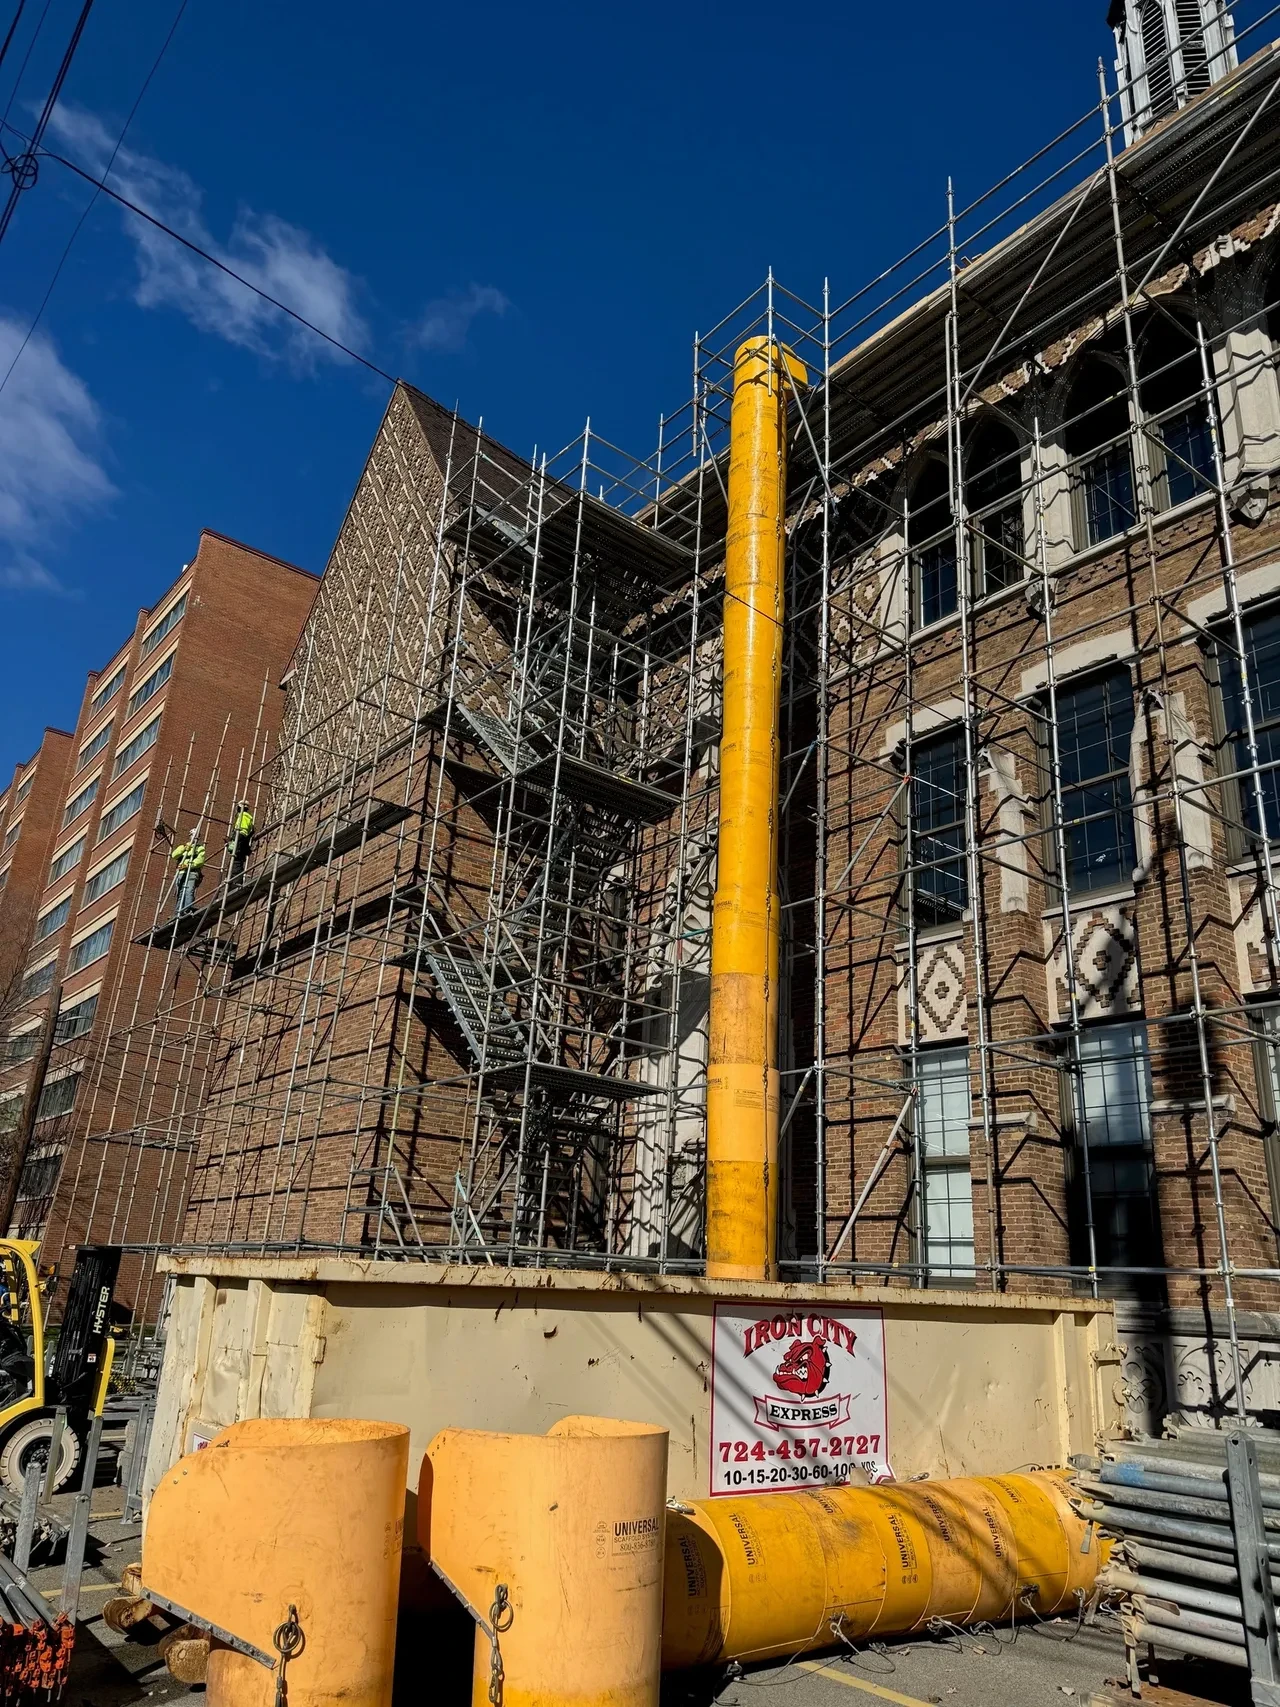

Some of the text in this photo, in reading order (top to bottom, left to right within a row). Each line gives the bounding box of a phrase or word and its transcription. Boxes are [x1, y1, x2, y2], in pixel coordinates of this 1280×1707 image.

[92, 1286, 110, 1334] HYSTER
[743, 1312, 858, 1358] IRON CITY
[769, 1403, 838, 1421] EXPRESS
[719, 1435, 881, 1463] 724-457-2727
[615, 1517, 659, 1536] UNIVERSAL
[729, 1513, 756, 1565] UNIVERSAL
[888, 1514, 909, 1568] UNIVERSAL
[923, 1496, 950, 1541] UNIVERSAL
[982, 1507, 1002, 1557] UNIVERSAL
[679, 1535, 696, 1597] UNIVERSAL
